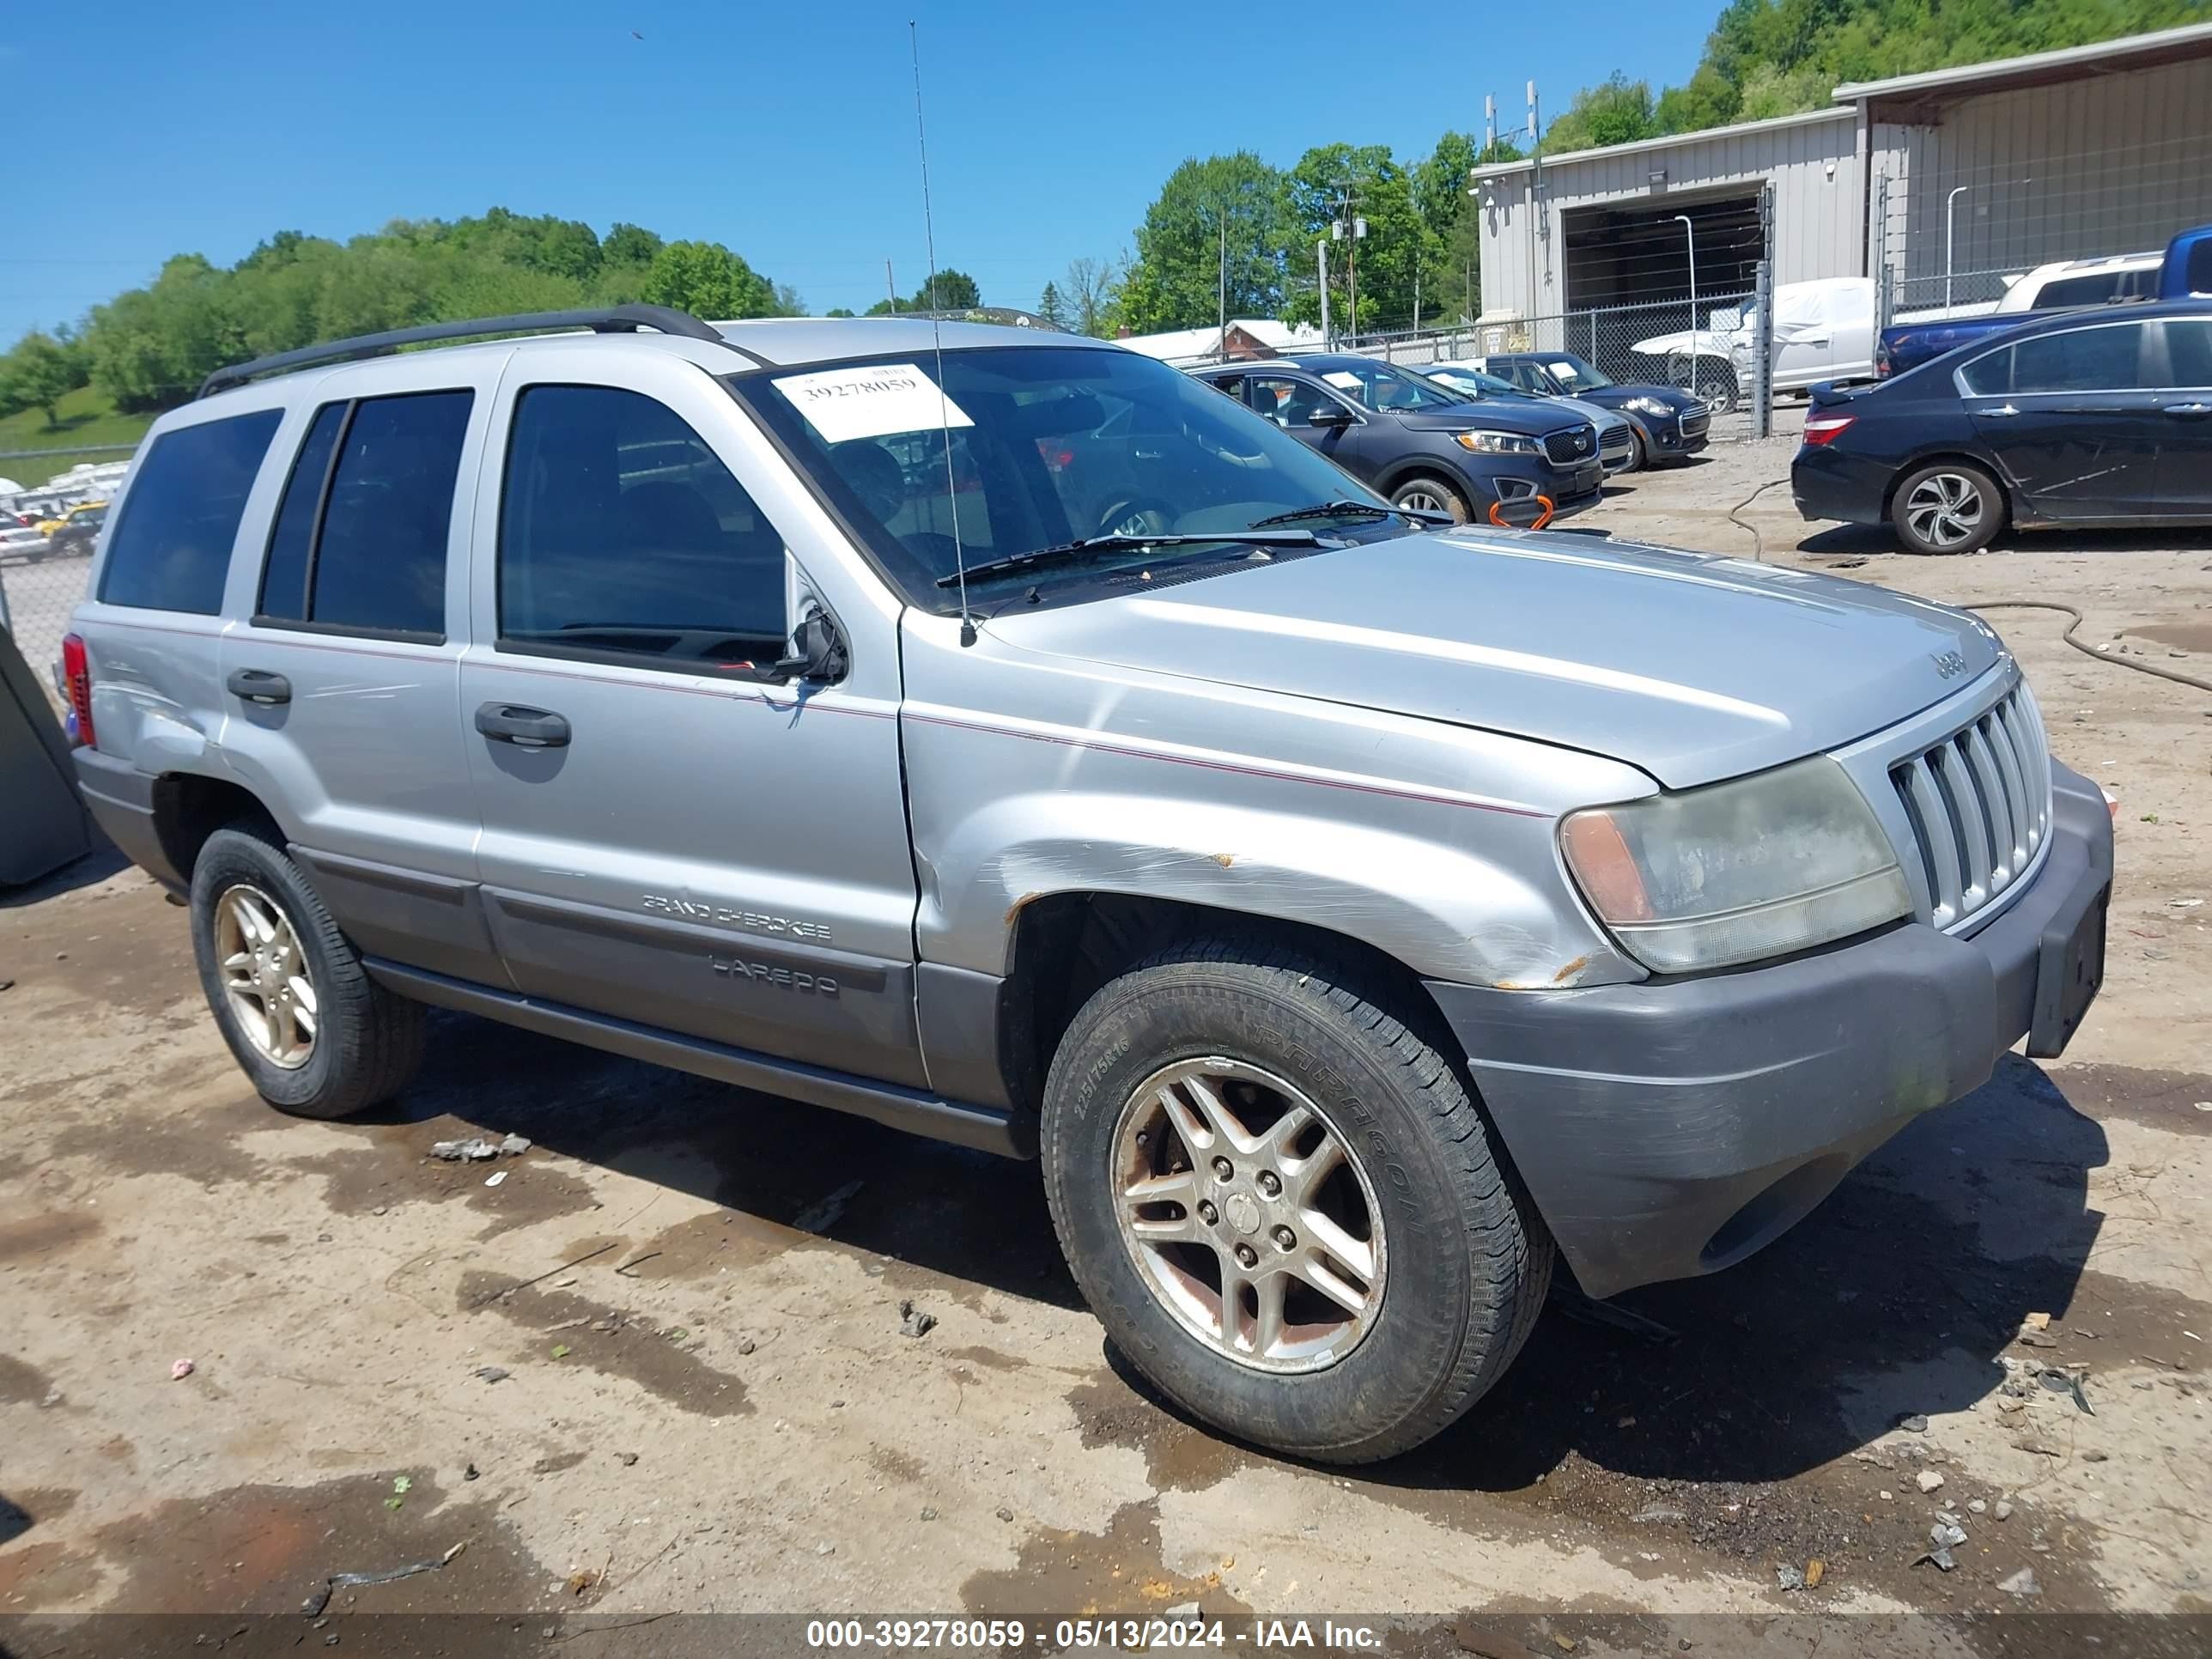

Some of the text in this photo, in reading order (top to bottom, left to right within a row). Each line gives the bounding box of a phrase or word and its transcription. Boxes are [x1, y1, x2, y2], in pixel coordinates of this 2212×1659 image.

[803, 379, 916, 401] 39278059
[1929, 650, 1969, 680] Jeep
[643, 894, 832, 939] GRAND CHEROKEE
[708, 955, 840, 994] LAREDO
[1251, 1024, 1429, 1234] PARAGON
